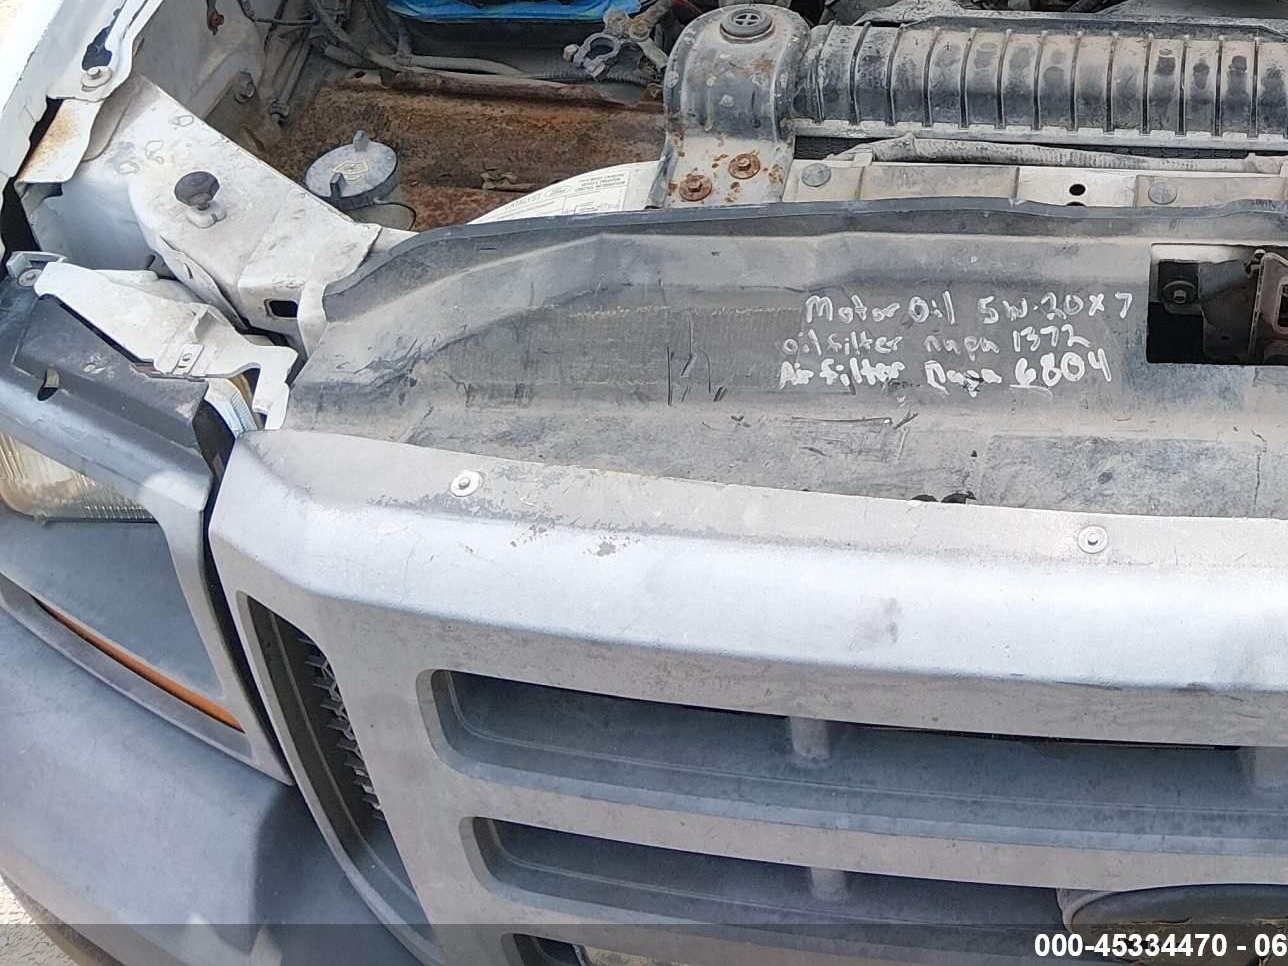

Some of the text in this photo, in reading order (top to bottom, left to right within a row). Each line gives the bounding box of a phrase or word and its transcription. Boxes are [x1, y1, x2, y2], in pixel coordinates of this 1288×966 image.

[806, 294, 900, 324] Motor
[908, 291, 956, 325] Oil
[1013, 324, 1092, 352] 1372
[1014, 347, 1113, 387] 6804
